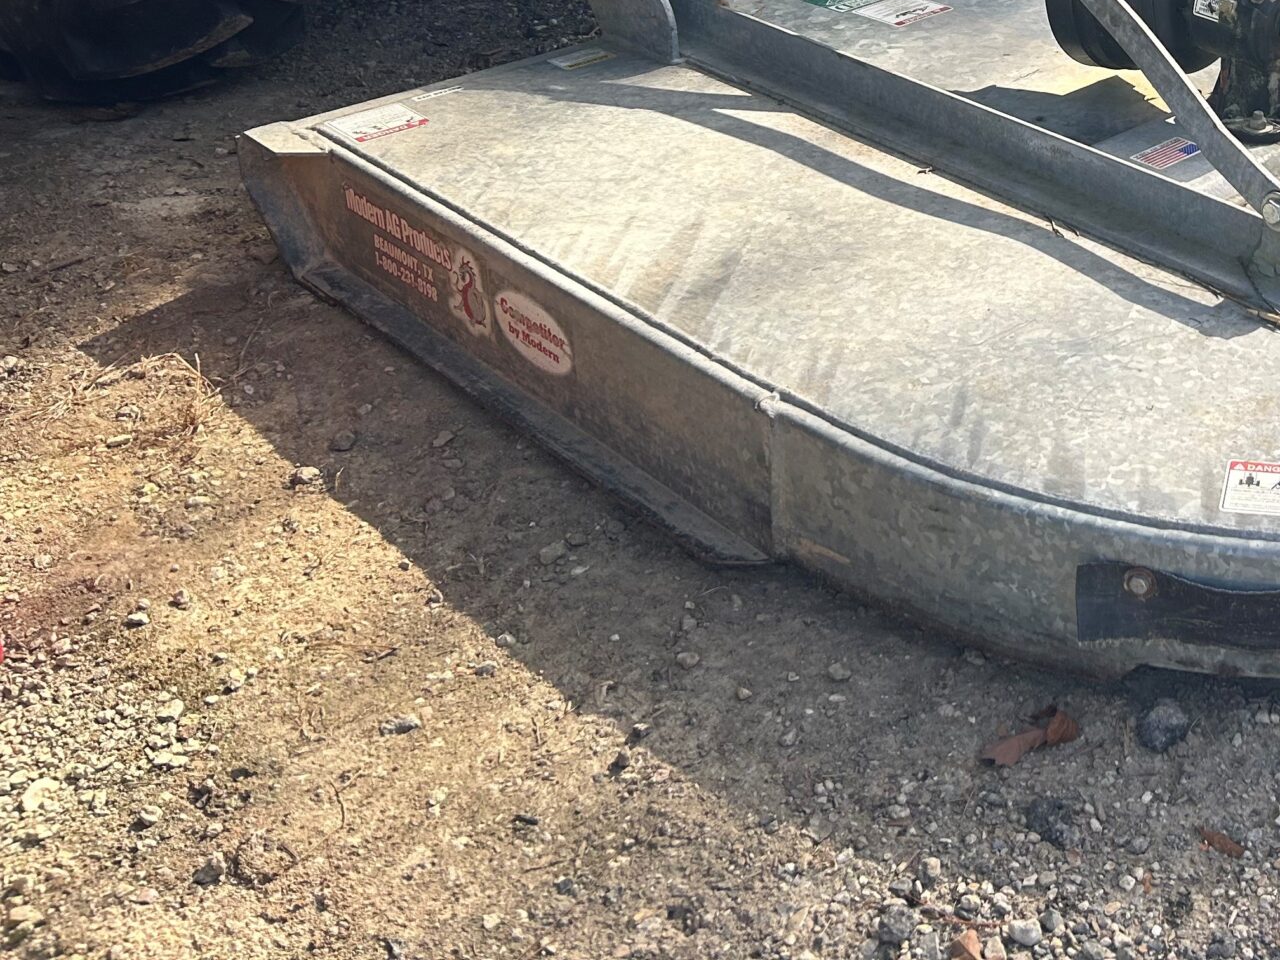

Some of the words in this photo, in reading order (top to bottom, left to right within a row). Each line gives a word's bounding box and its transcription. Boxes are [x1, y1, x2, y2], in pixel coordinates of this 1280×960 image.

[345, 188, 386, 230] Modern
[386, 209, 402, 240] AG
[401, 218, 453, 271] Products
[374, 234, 421, 275] BEAUMONT,
[422, 264, 434, 282] TX
[500, 297, 566, 350] Competitor
[508, 320, 520, 339] by
[521, 330, 560, 364] Modern
